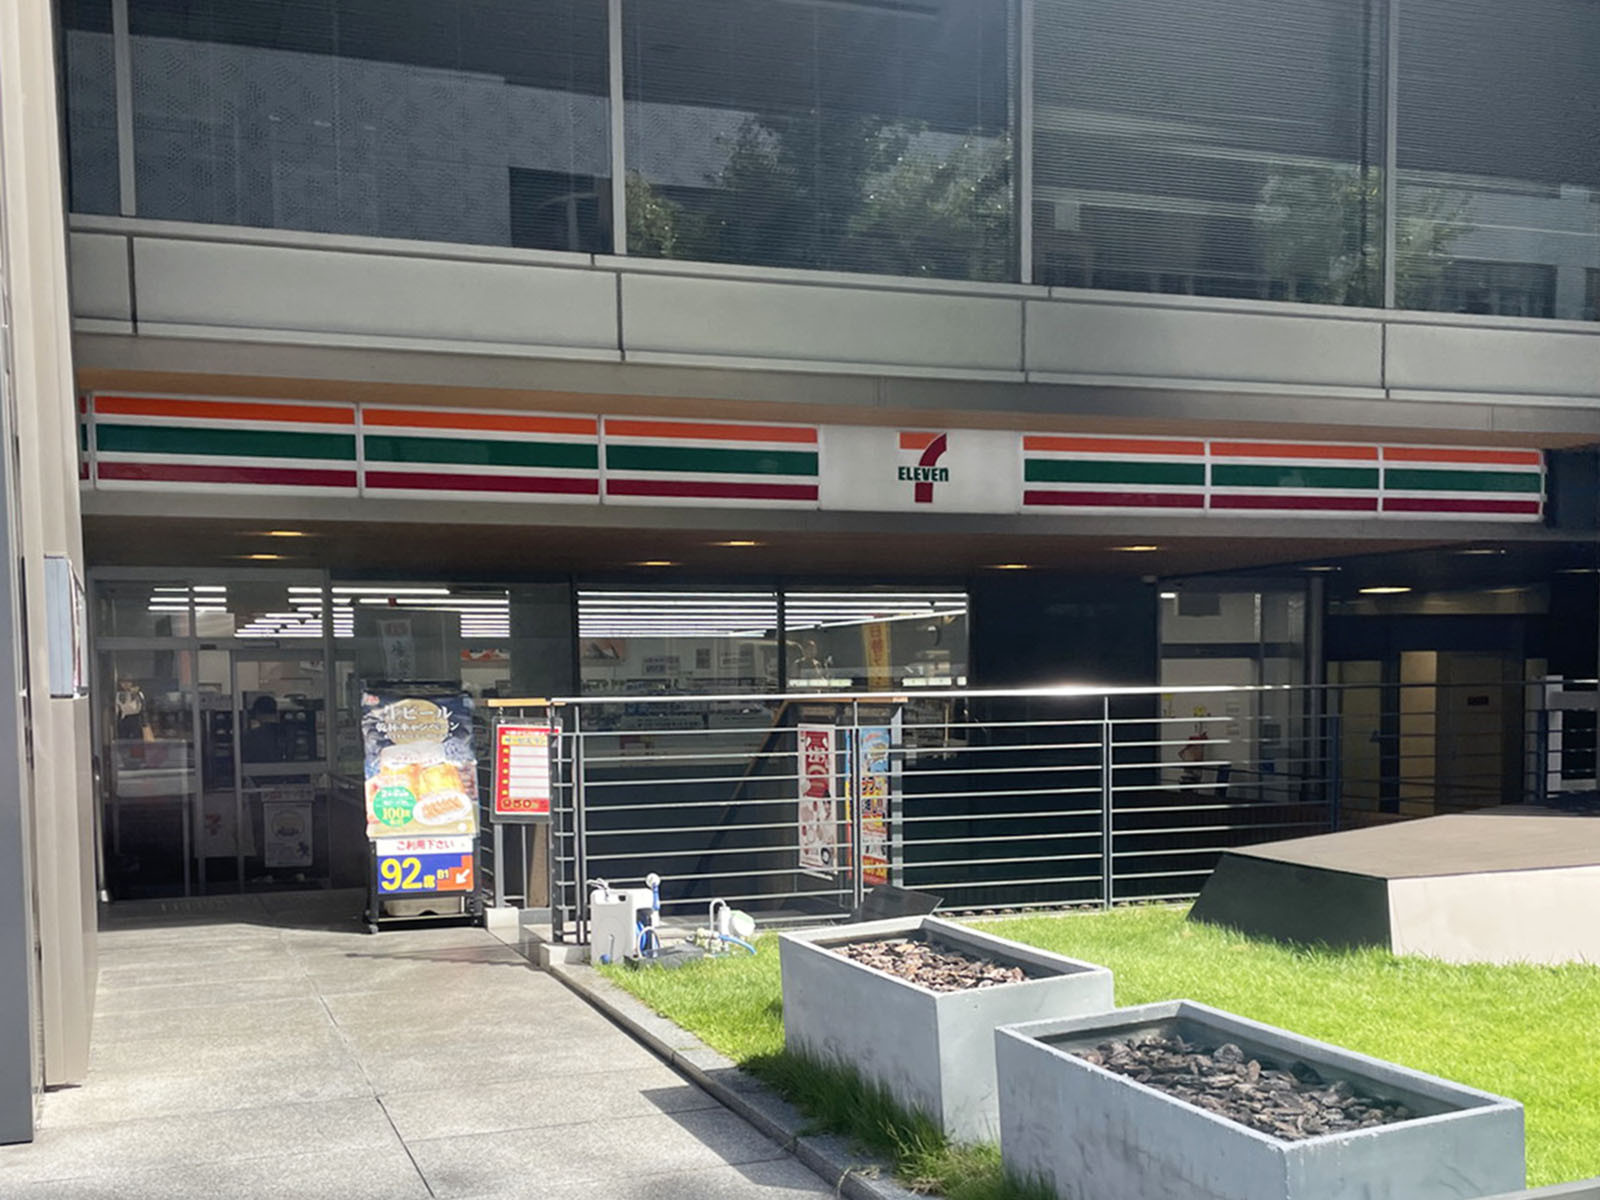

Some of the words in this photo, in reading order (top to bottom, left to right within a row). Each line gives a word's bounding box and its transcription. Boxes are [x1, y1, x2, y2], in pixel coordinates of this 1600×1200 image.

[899, 431, 947, 503] 7
[397, 840, 455, 850] ご利用下さい
